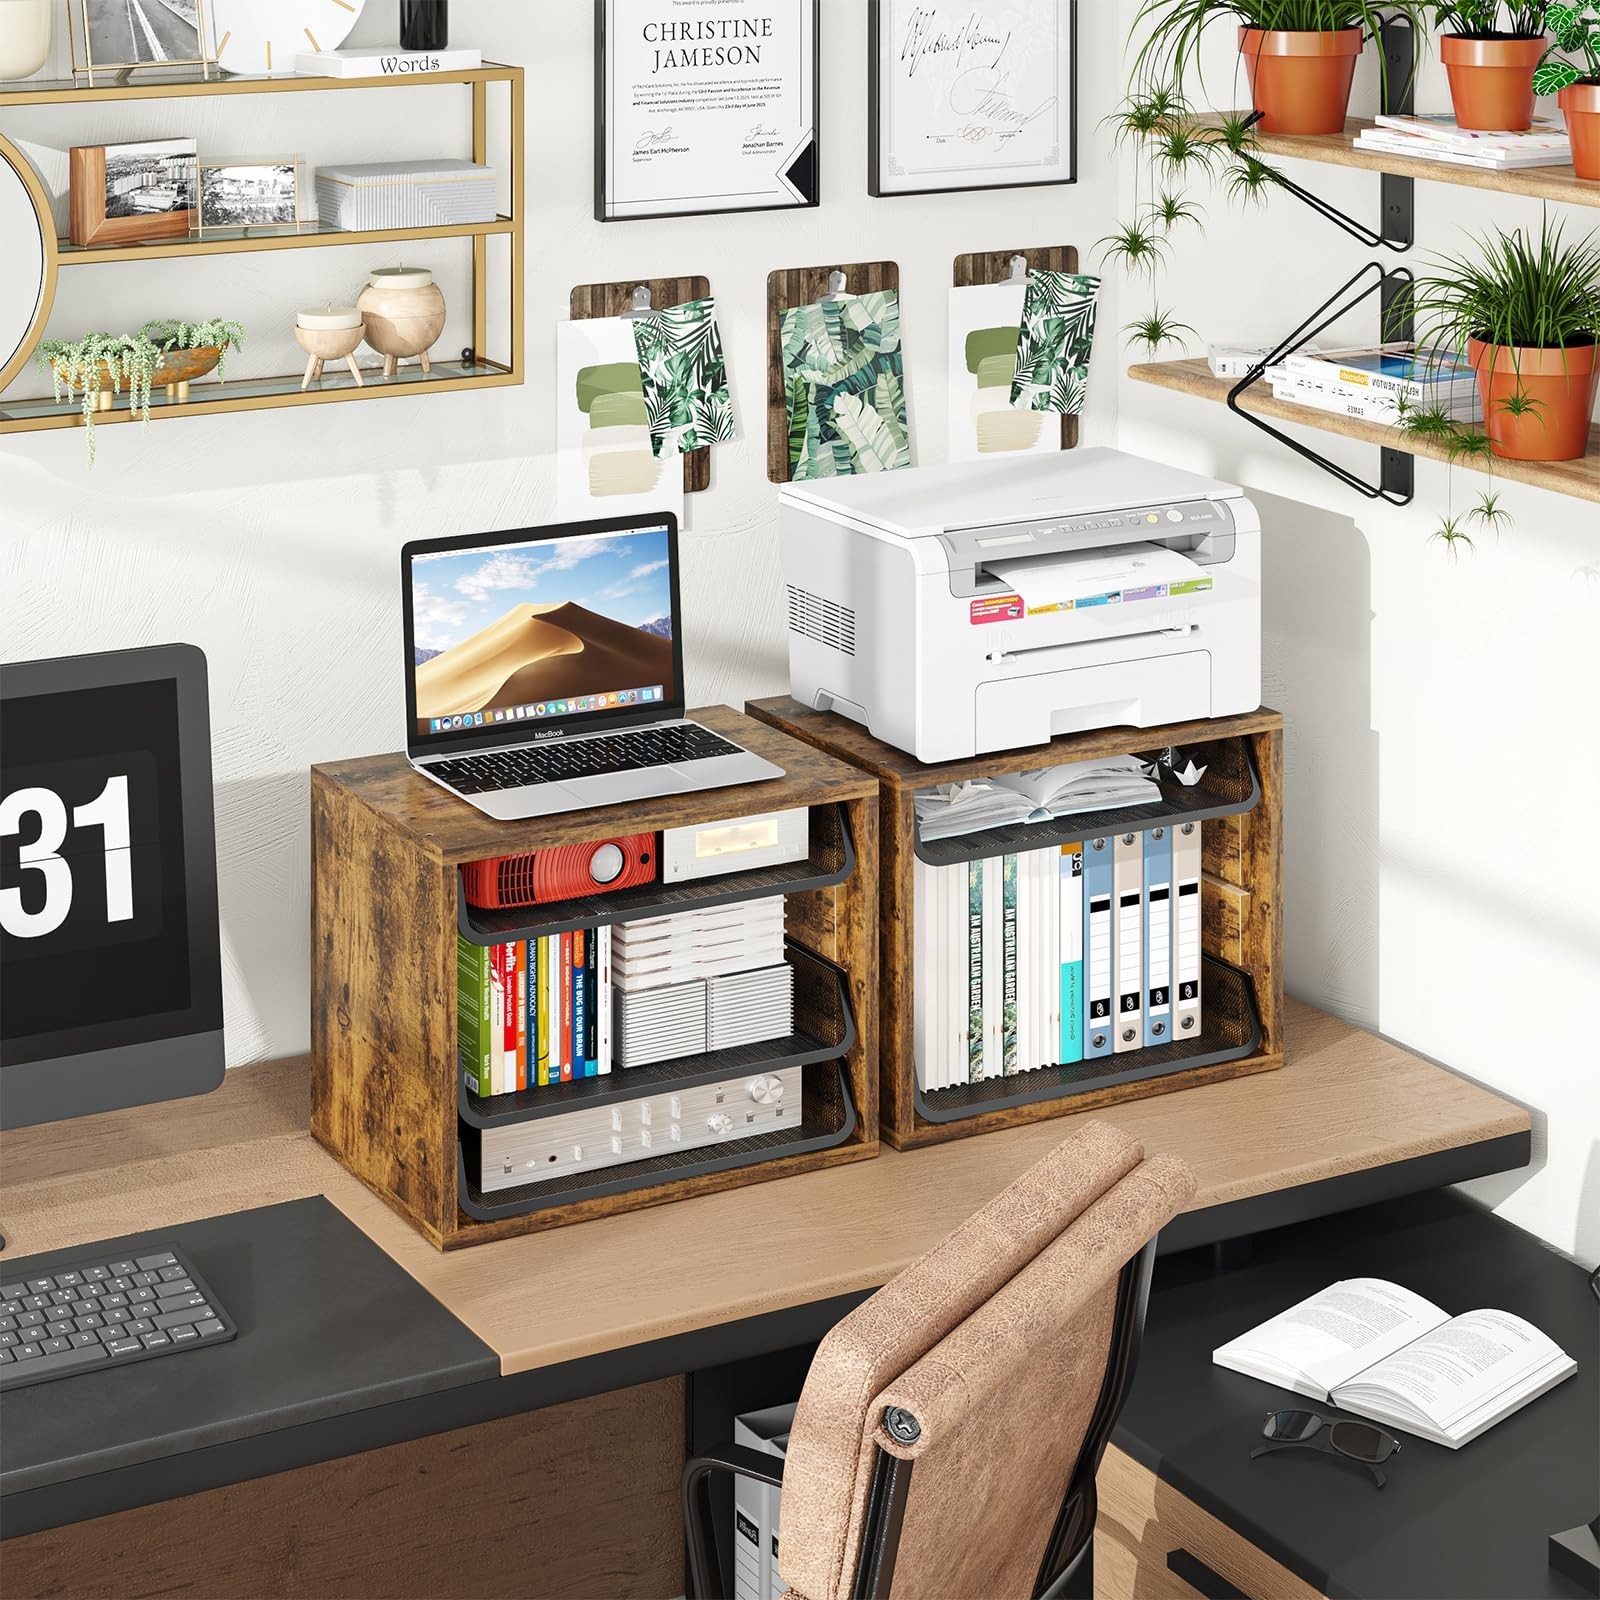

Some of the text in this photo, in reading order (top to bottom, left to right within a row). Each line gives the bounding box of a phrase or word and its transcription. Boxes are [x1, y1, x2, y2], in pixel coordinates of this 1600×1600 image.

[643, 18, 773, 42] CHRISTINE
[381, 56, 440, 75] Words
[652, 45, 761, 73] JAMESON
[534, 729, 564, 739] MacBook
[0, 775, 134, 938] 31
[505, 941, 516, 973] Berlitz
[529, 939, 537, 1017] HUMAN RIGHTS ADVOCACY
[970, 914, 981, 1011] AN AUSTRALIAN GARDEN
[1004, 908, 1016, 1005] AN AUSTRALIAN GARDEN
[576, 974, 584, 1057] THE BUG IN OUR BRAIN
